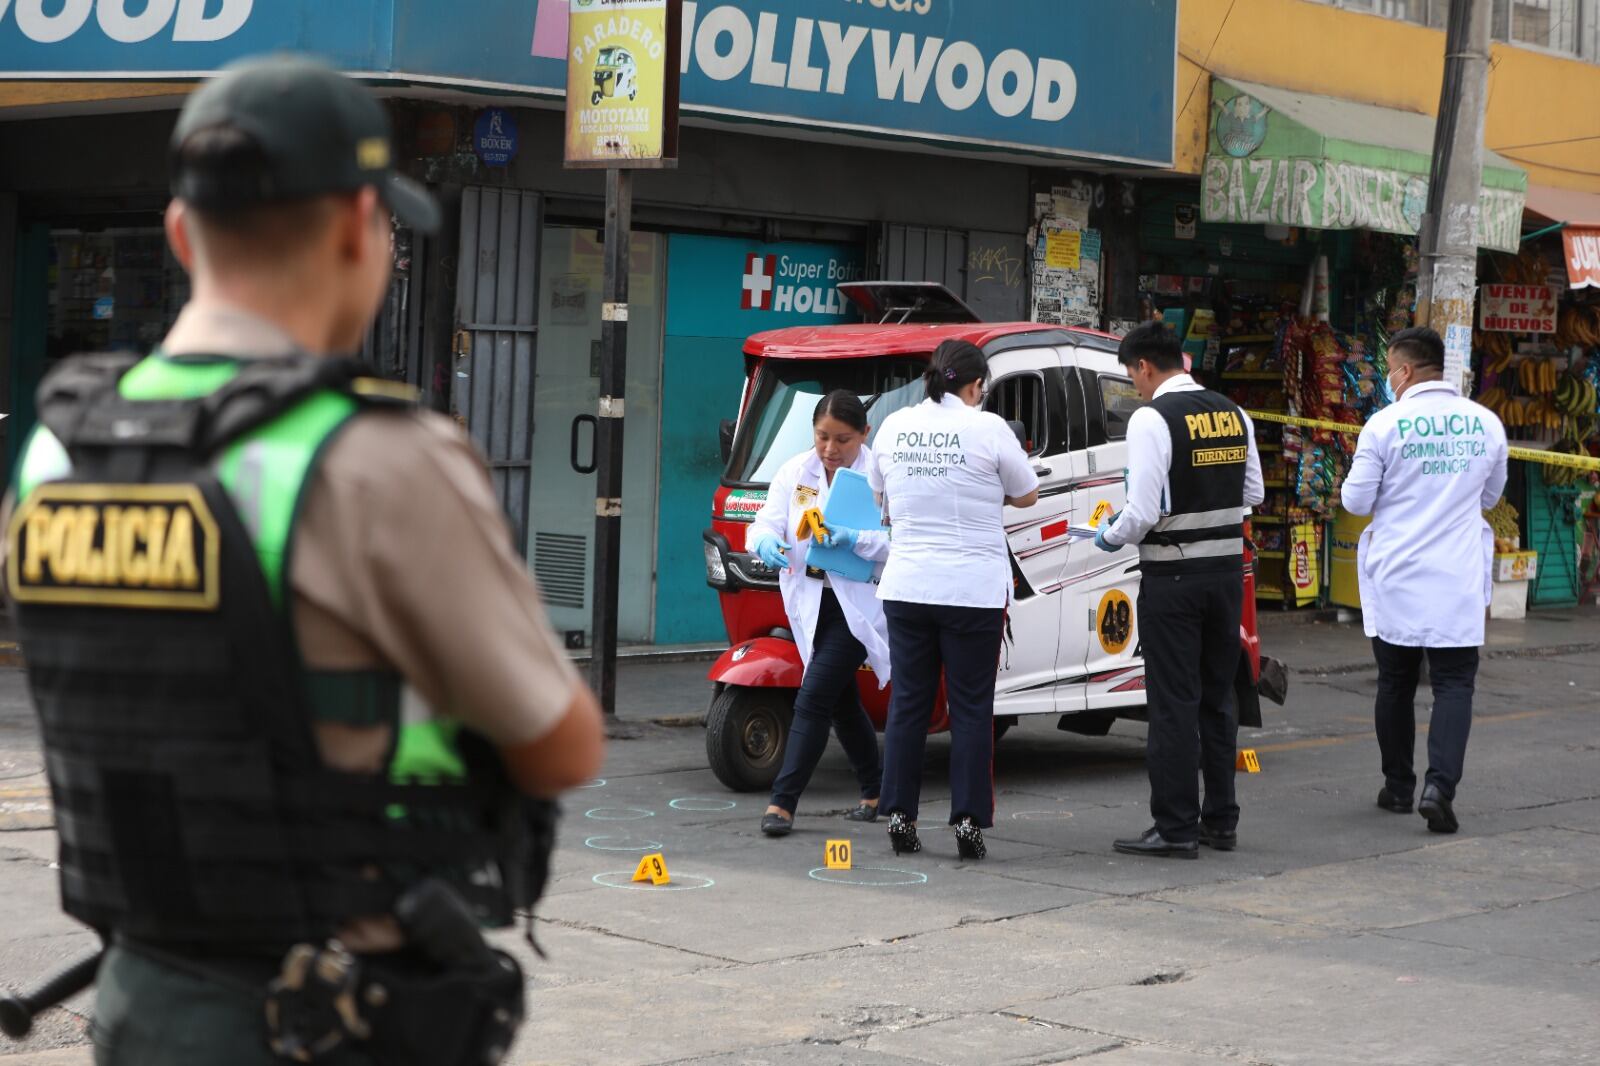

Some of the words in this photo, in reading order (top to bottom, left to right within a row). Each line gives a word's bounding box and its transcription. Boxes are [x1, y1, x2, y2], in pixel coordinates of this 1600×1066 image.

[573, 16, 662, 64] PARADERO
[580, 107, 649, 124] MOTOTAXI
[481, 138, 512, 150] BOXER
[1204, 158, 1317, 227] BAZAR
[779, 255, 823, 283] Super
[774, 285, 849, 315] HOLLY
[1488, 285, 1551, 299] VENTA
[1509, 303, 1529, 314] DE
[1484, 317, 1553, 331] HUEVOS
[1398, 414, 1485, 439] POLICIA
[897, 432, 961, 449] POLICIA
[892, 449, 967, 465] CRIMINALÍSTICA
[907, 466, 948, 477] DIRINCRI
[1422, 459, 1470, 475] DIRINCRI
[1094, 503, 1105, 520] 12
[24, 504, 199, 587] POLICIA
[1101, 600, 1130, 645] 49
[829, 844, 849, 862] 10
[652, 857, 663, 877] 9
